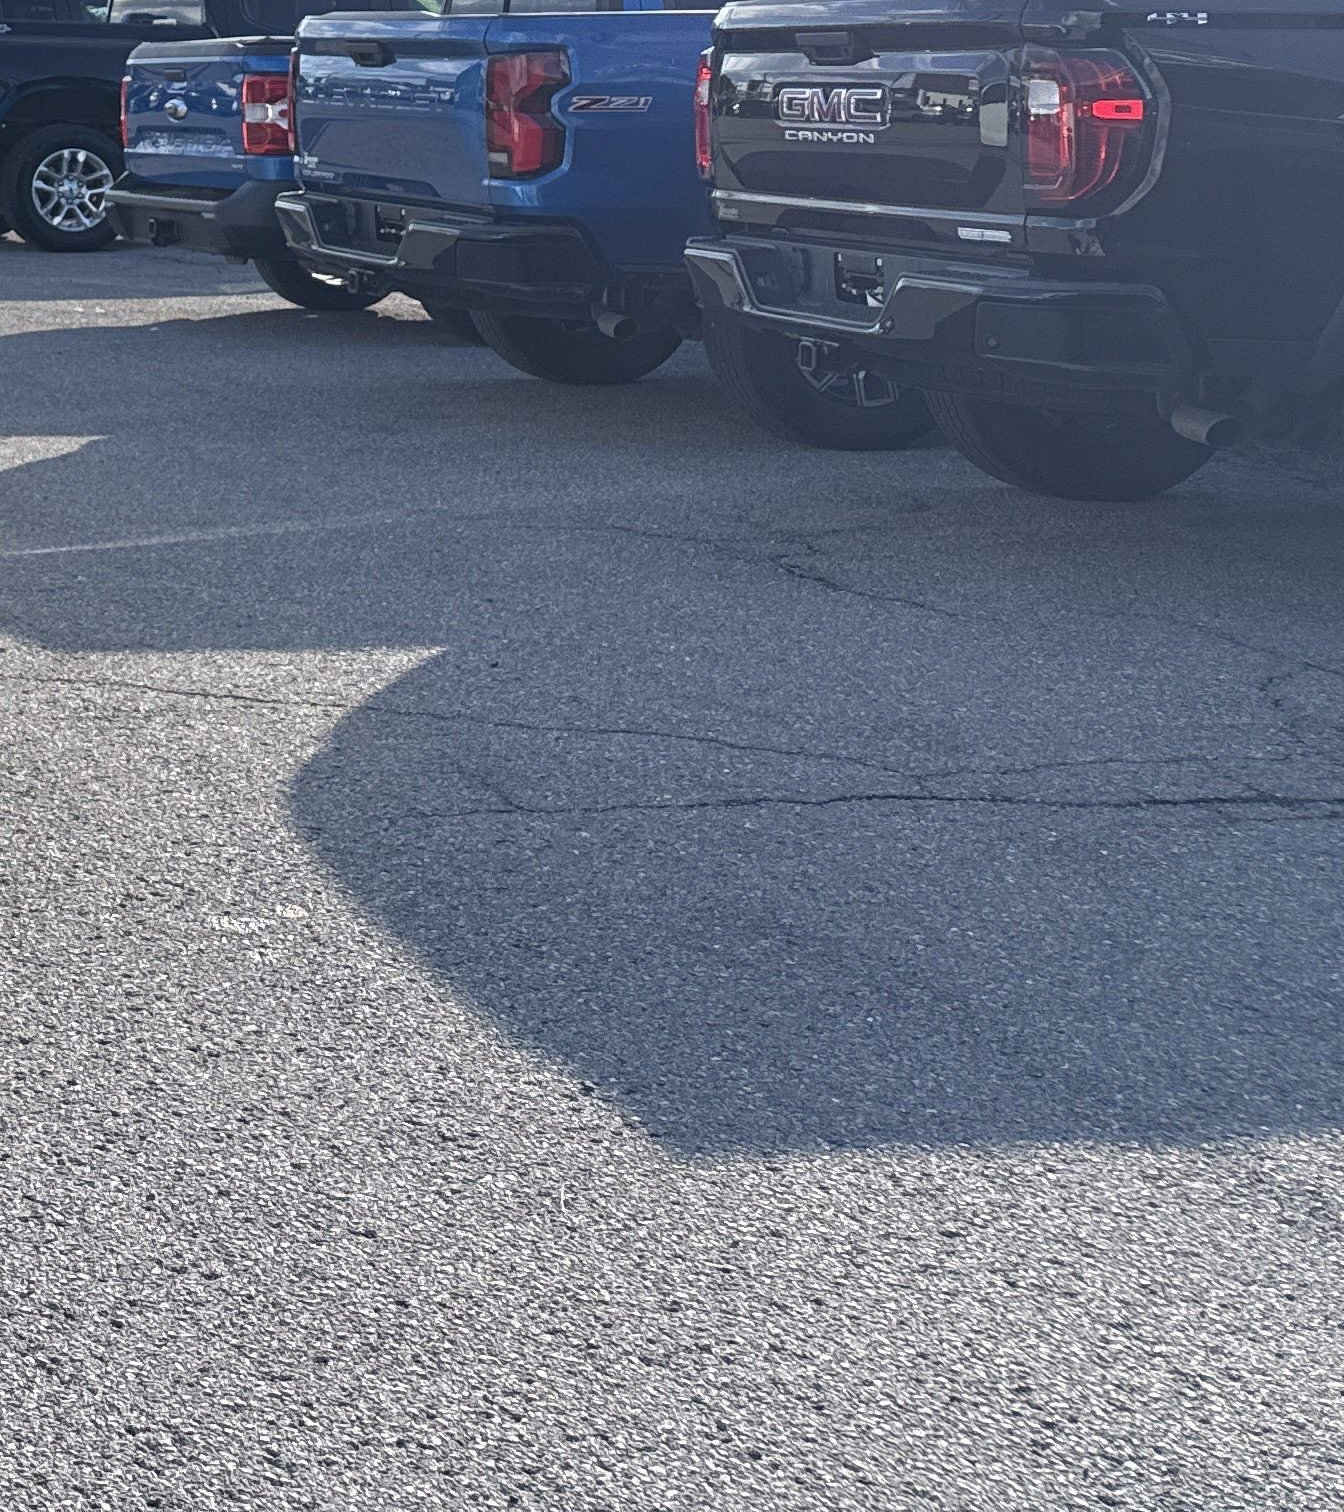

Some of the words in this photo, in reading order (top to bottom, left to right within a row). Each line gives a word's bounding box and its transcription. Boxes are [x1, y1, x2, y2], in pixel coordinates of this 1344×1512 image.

[568, 95, 653, 112] Z71
[777, 88, 883, 123] GMC
[784, 130, 875, 144] CANYON
